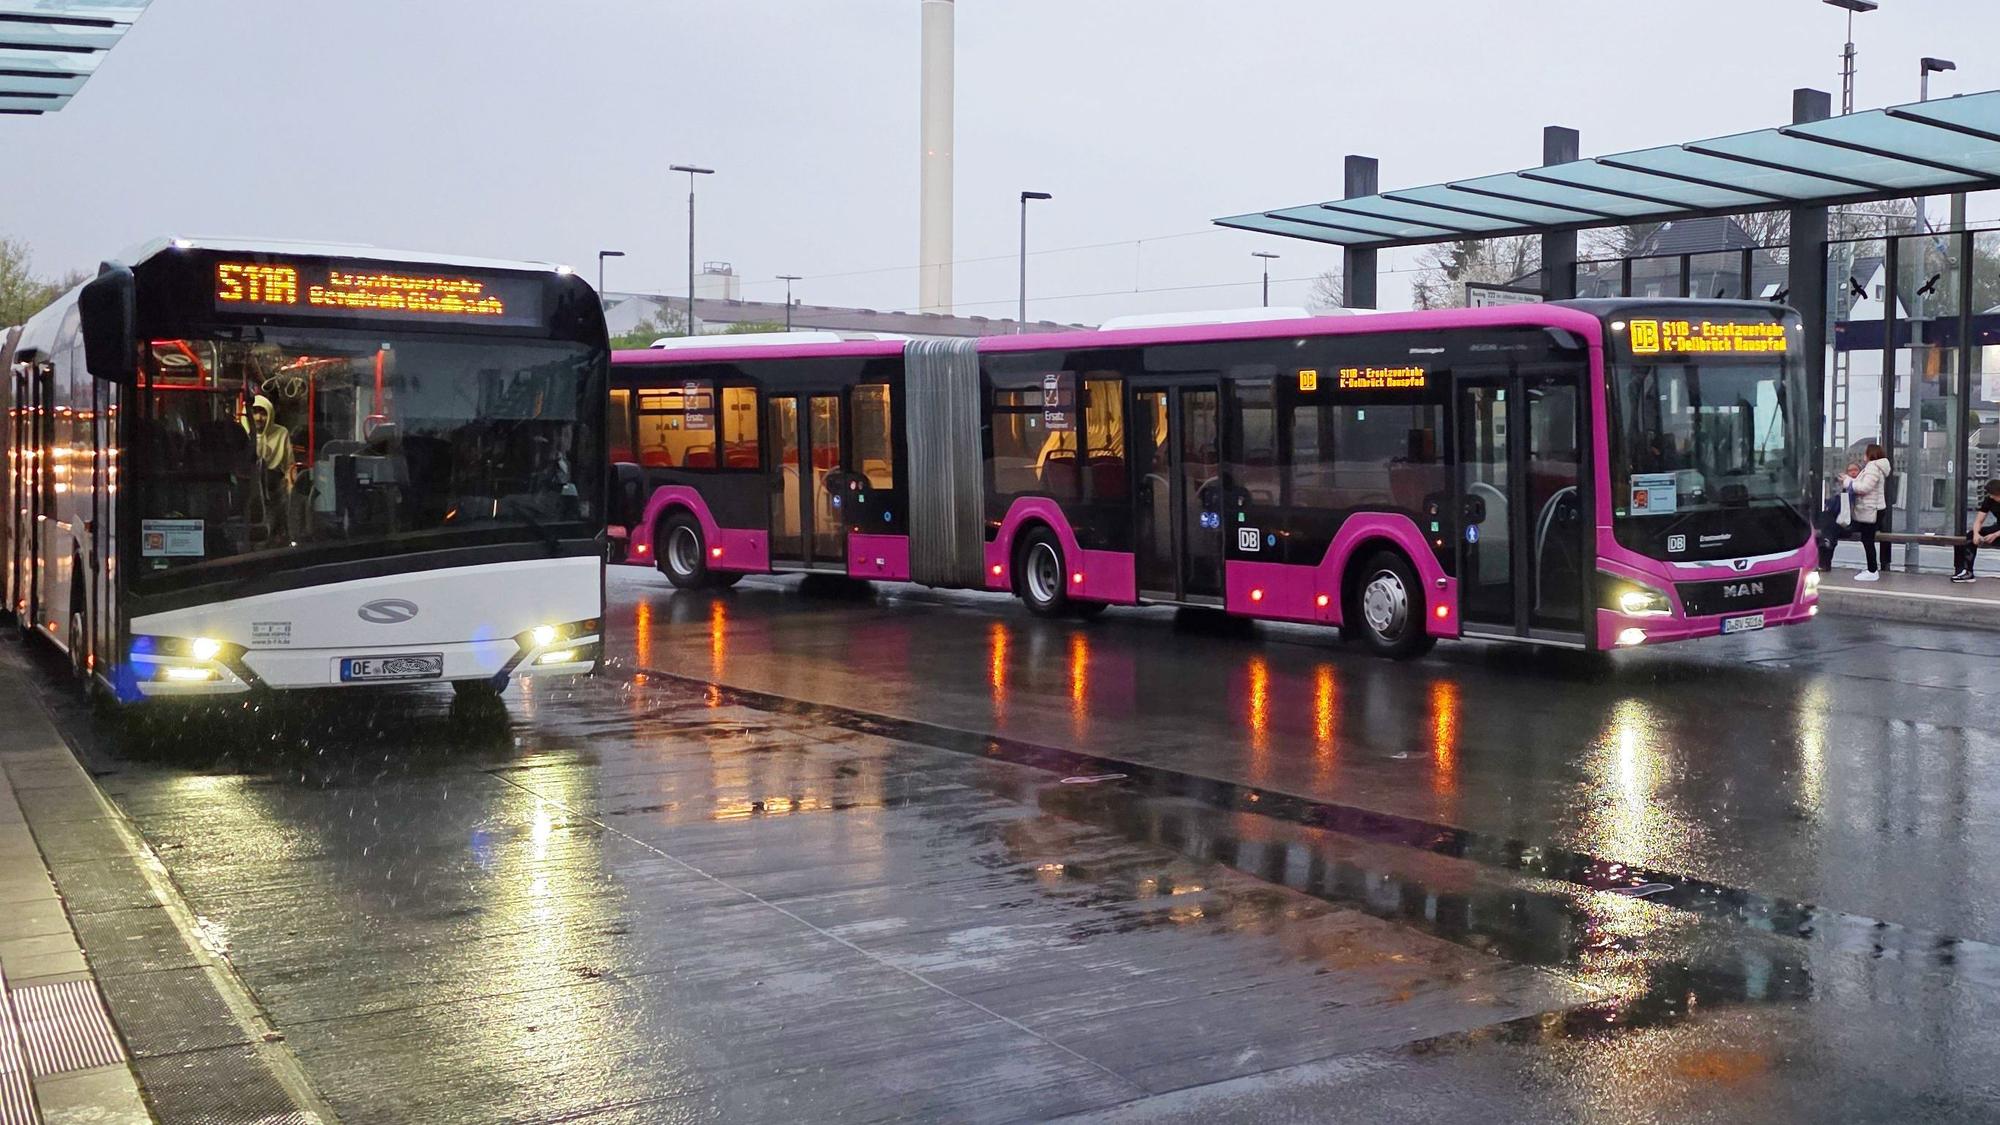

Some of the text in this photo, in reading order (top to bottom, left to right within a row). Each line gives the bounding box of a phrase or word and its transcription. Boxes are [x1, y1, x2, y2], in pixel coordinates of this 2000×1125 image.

[1633, 323, 1656, 348] DB
[1702, 321, 1785, 337] Ersatzverkehr
[1301, 372, 1315, 388] DB
[1045, 411, 1064, 421] Ersatz
[1241, 530, 1258, 549] DB
[1669, 536, 1684, 551] DB
[1723, 582, 1764, 598] MAN
[352, 661, 371, 675] OE
